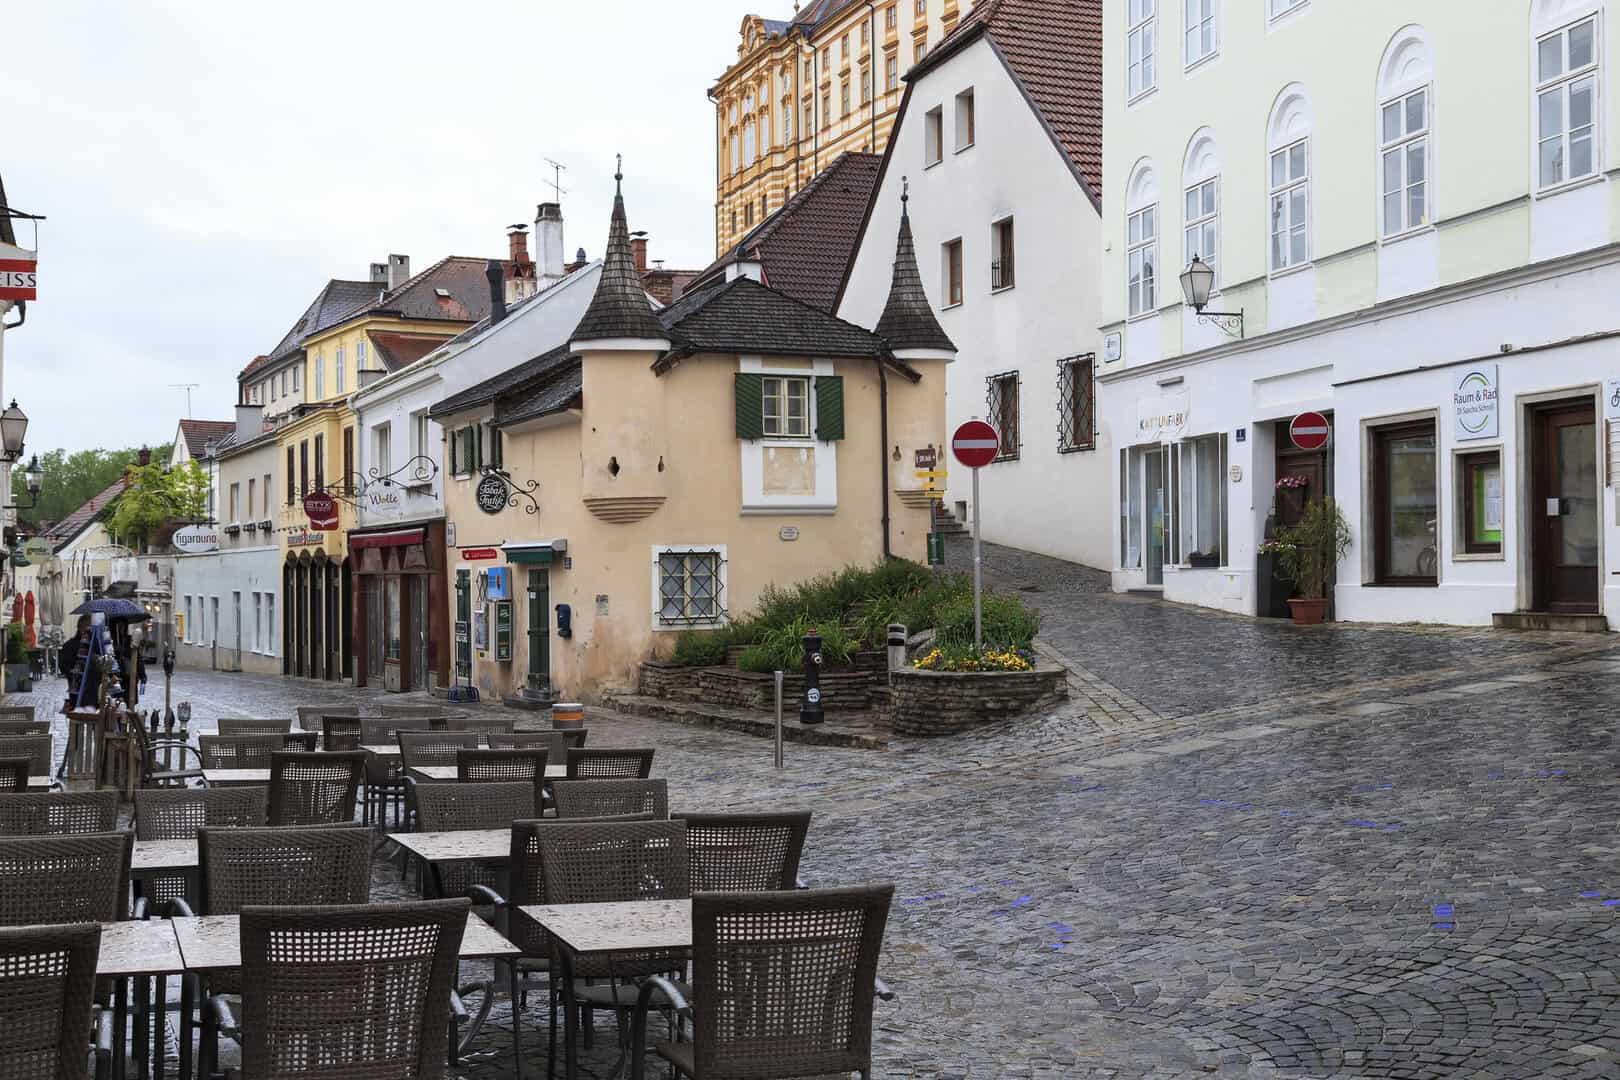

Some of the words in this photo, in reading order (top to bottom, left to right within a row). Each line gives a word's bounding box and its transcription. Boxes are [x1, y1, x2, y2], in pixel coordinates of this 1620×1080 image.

[1454, 393, 1474, 404] Raum
[1476, 390, 1482, 401] &
[1483, 387, 1497, 400] Rad
[480, 484, 504, 495] Tabak
[175, 531, 217, 546] figaround
